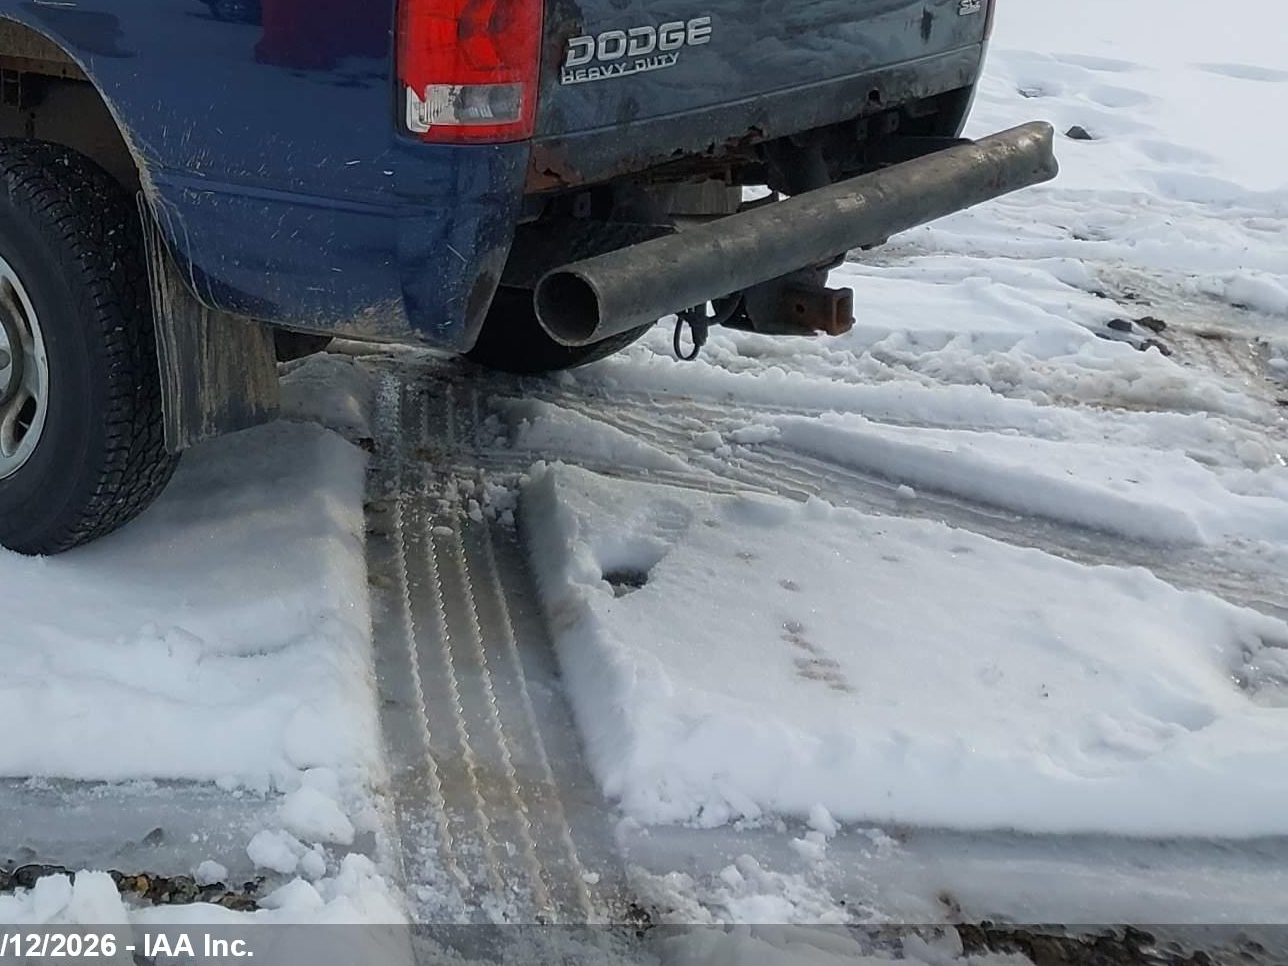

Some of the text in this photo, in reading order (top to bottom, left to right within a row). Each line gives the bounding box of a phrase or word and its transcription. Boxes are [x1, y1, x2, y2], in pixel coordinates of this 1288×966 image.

[565, 16, 713, 67] DODGE
[561, 52, 680, 84] HEAVY DUTY
